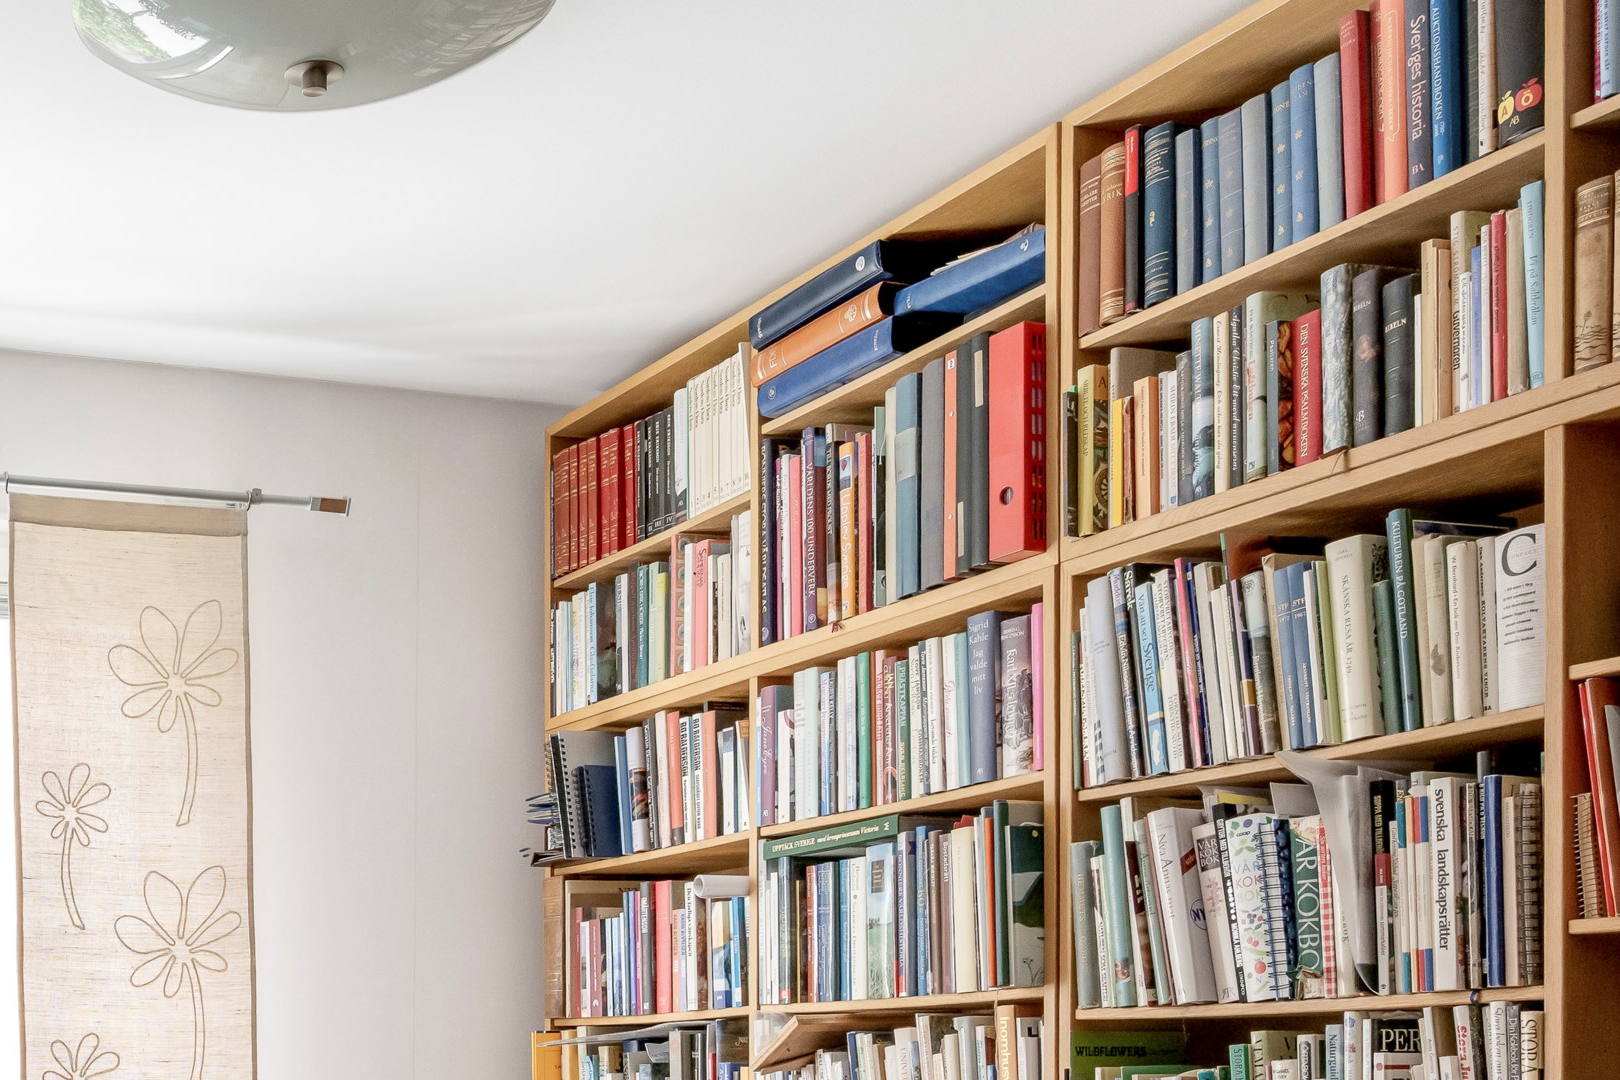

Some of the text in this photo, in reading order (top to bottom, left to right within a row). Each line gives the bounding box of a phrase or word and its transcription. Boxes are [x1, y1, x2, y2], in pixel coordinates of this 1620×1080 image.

[1431, 7, 1443, 121] AUKTIONSHANDBOKEN
[1407, 14, 1427, 141] Sveriges historia
[1353, 299, 1372, 313] BIBELN
[1528, 280, 1540, 326] Saltkråkan
[1231, 312, 1241, 346] Agatha
[1384, 317, 1407, 332] BIBELN
[1300, 323, 1308, 457] DEN SVENSKA PSALMBOKEN
[1232, 399, 1241, 422] mord
[805, 462, 816, 598] VÄRLDENS 100 UNDERVERK
[840, 493, 852, 590] Upplev Sverige
[1112, 574, 1122, 606] Muddus
[1123, 570, 1136, 611] Sarek
[1391, 520, 1408, 639] KULTUREN PÅ GOTLAND
[1292, 597, 1306, 607] STF
[968, 618, 989, 633] Sigrid
[968, 632, 989, 645] Kahle
[1344, 618, 1352, 640] RESA
[970, 660, 988, 671] valde
[972, 648, 984, 659] Jag
[1006, 648, 1018, 672] Karl
[971, 673, 986, 684] mitt
[1144, 642, 1156, 692] Sverige
[899, 666, 907, 727] PRÄSTKAPPAN
[974, 685, 983, 695] liv
[1119, 634, 1129, 660] Edvin
[1128, 730, 1139, 771] Arvidsson
[761, 721, 773, 775] Jane Eyre
[1373, 795, 1381, 814] SOPPA
[1374, 814, 1382, 827] MED
[771, 841, 794, 853] UPPTÄCK
[793, 837, 816, 849] SVERIGE
[860, 824, 880, 834] Victoria
[1197, 838, 1217, 850] VÅR
[1236, 830, 1251, 838] coop
[1199, 848, 1219, 859] KOK
[1216, 818, 1225, 839] GRYTOR
[1221, 850, 1231, 878] TILLBEHÖR
[942, 840, 950, 883] Bostadsrätt
[1200, 856, 1220, 867] BOK
[1233, 859, 1260, 875] VÅR
[1434, 788, 1450, 951] svenska landskapsrätter
[1161, 859, 1174, 895] Annas
[1235, 874, 1263, 889] KOK
[1295, 836, 1320, 970] ÅR KOKBO
[1509, 1017, 1517, 1033] Din
[1074, 1045, 1147, 1057] WILDFLOWERS
[1456, 1025, 1468, 1061] Stora
[1510, 1033, 1518, 1064] Kokbok
[1521, 1018, 1540, 1074] STORA
[1233, 1049, 1243, 1075] STORA
[1510, 1063, 1519, 1075] för
